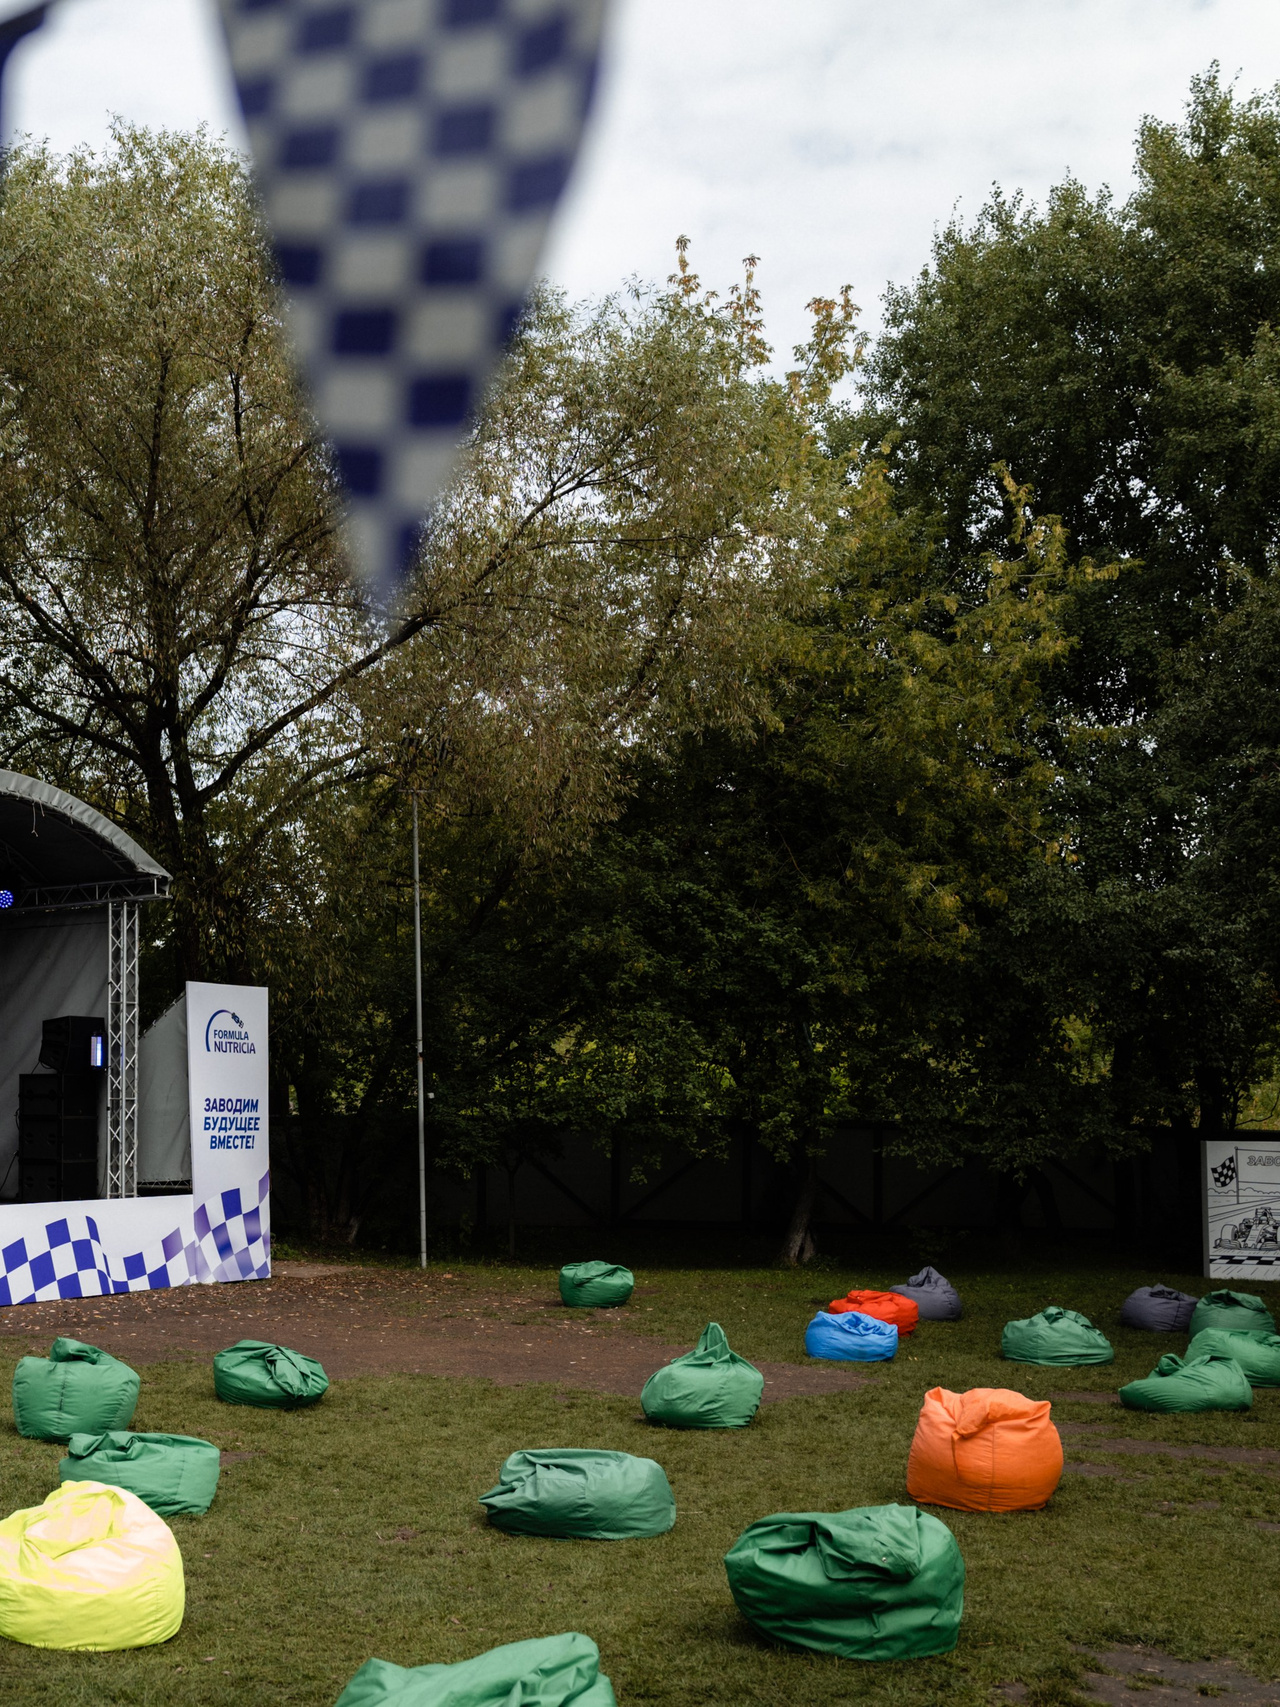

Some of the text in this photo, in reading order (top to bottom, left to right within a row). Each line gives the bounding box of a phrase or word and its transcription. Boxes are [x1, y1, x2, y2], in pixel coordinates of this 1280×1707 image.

[213, 1029, 249, 1040] FORMULA
[214, 1040, 256, 1054] NUTRICIA
[204, 1098, 259, 1115] ЗАВОДИМ
[203, 1116, 260, 1133] БУДУЩЕЕ
[209, 1135, 255, 1150] ВМЕСТЕ!
